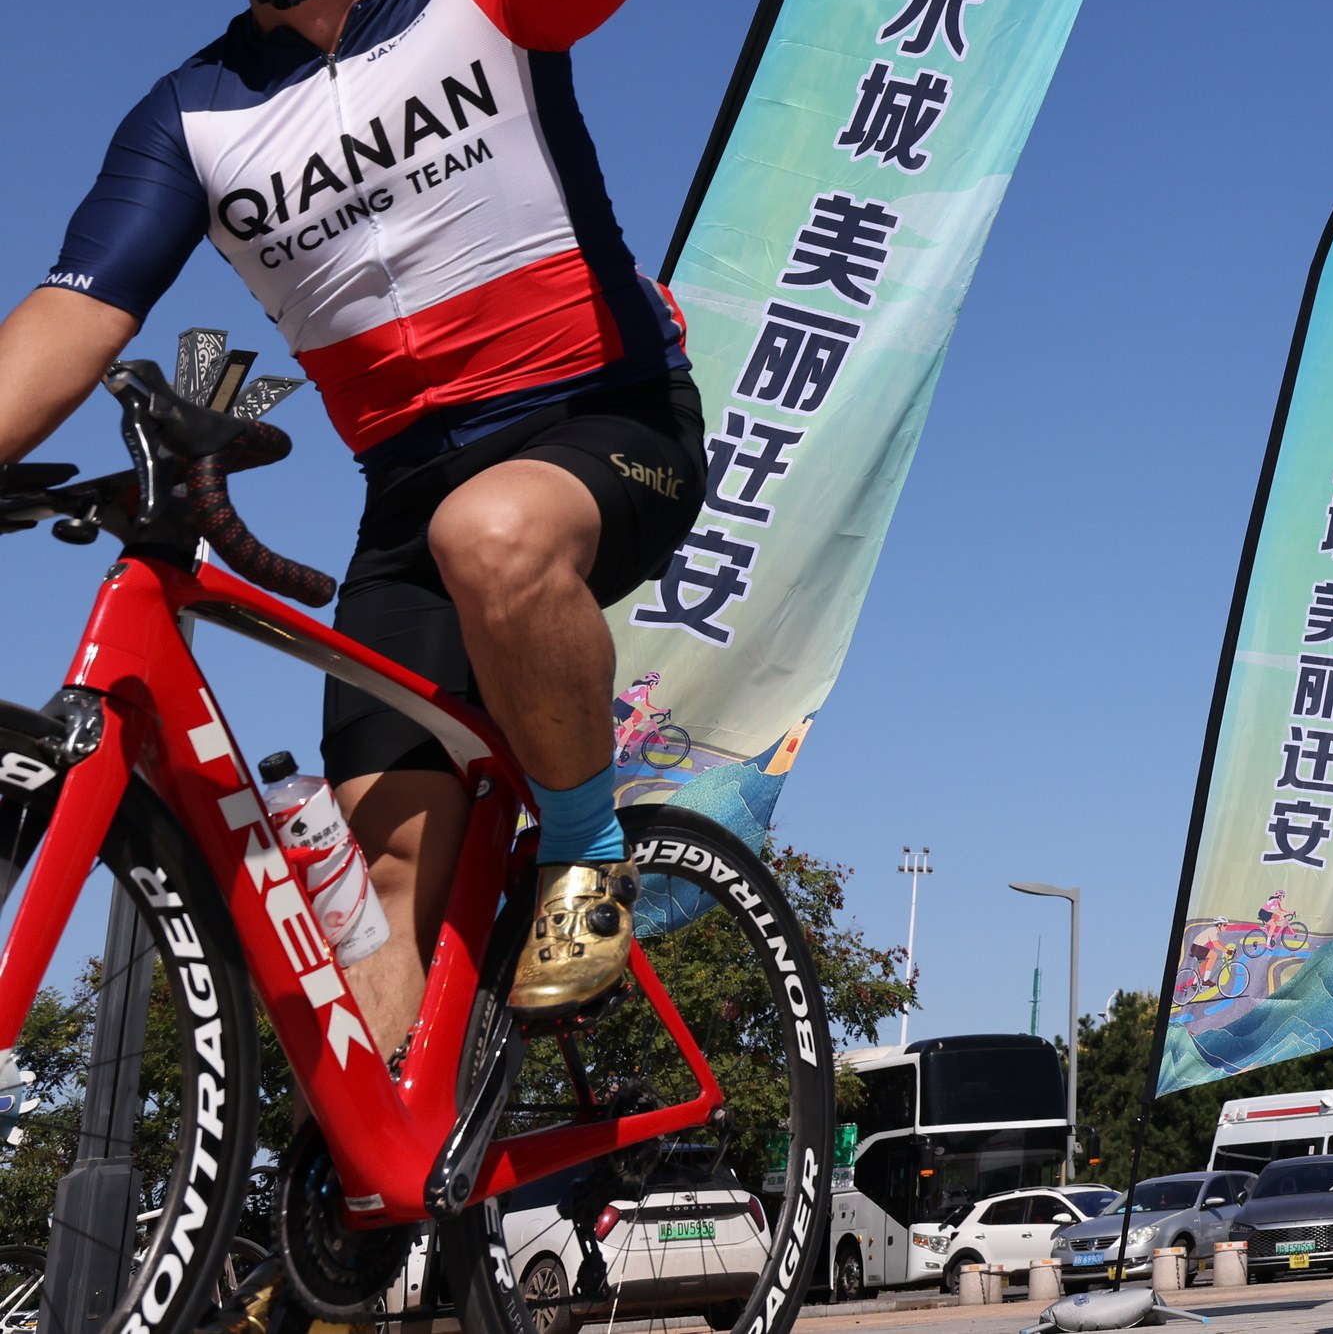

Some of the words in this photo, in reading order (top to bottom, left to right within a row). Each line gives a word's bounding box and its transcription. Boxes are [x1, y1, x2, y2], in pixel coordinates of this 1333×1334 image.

[217, 60, 499, 241] QIANAN
[259, 188, 394, 270] CYCLING
[406, 138, 493, 196] TEAM
[609, 452, 686, 501] Santic
[632, 191, 896, 646] 美丽迁安
[186, 686, 374, 1070] TREK
[632, 838, 818, 1068] BONTRAGER
[666, 1204, 712, 1212] COOPER
